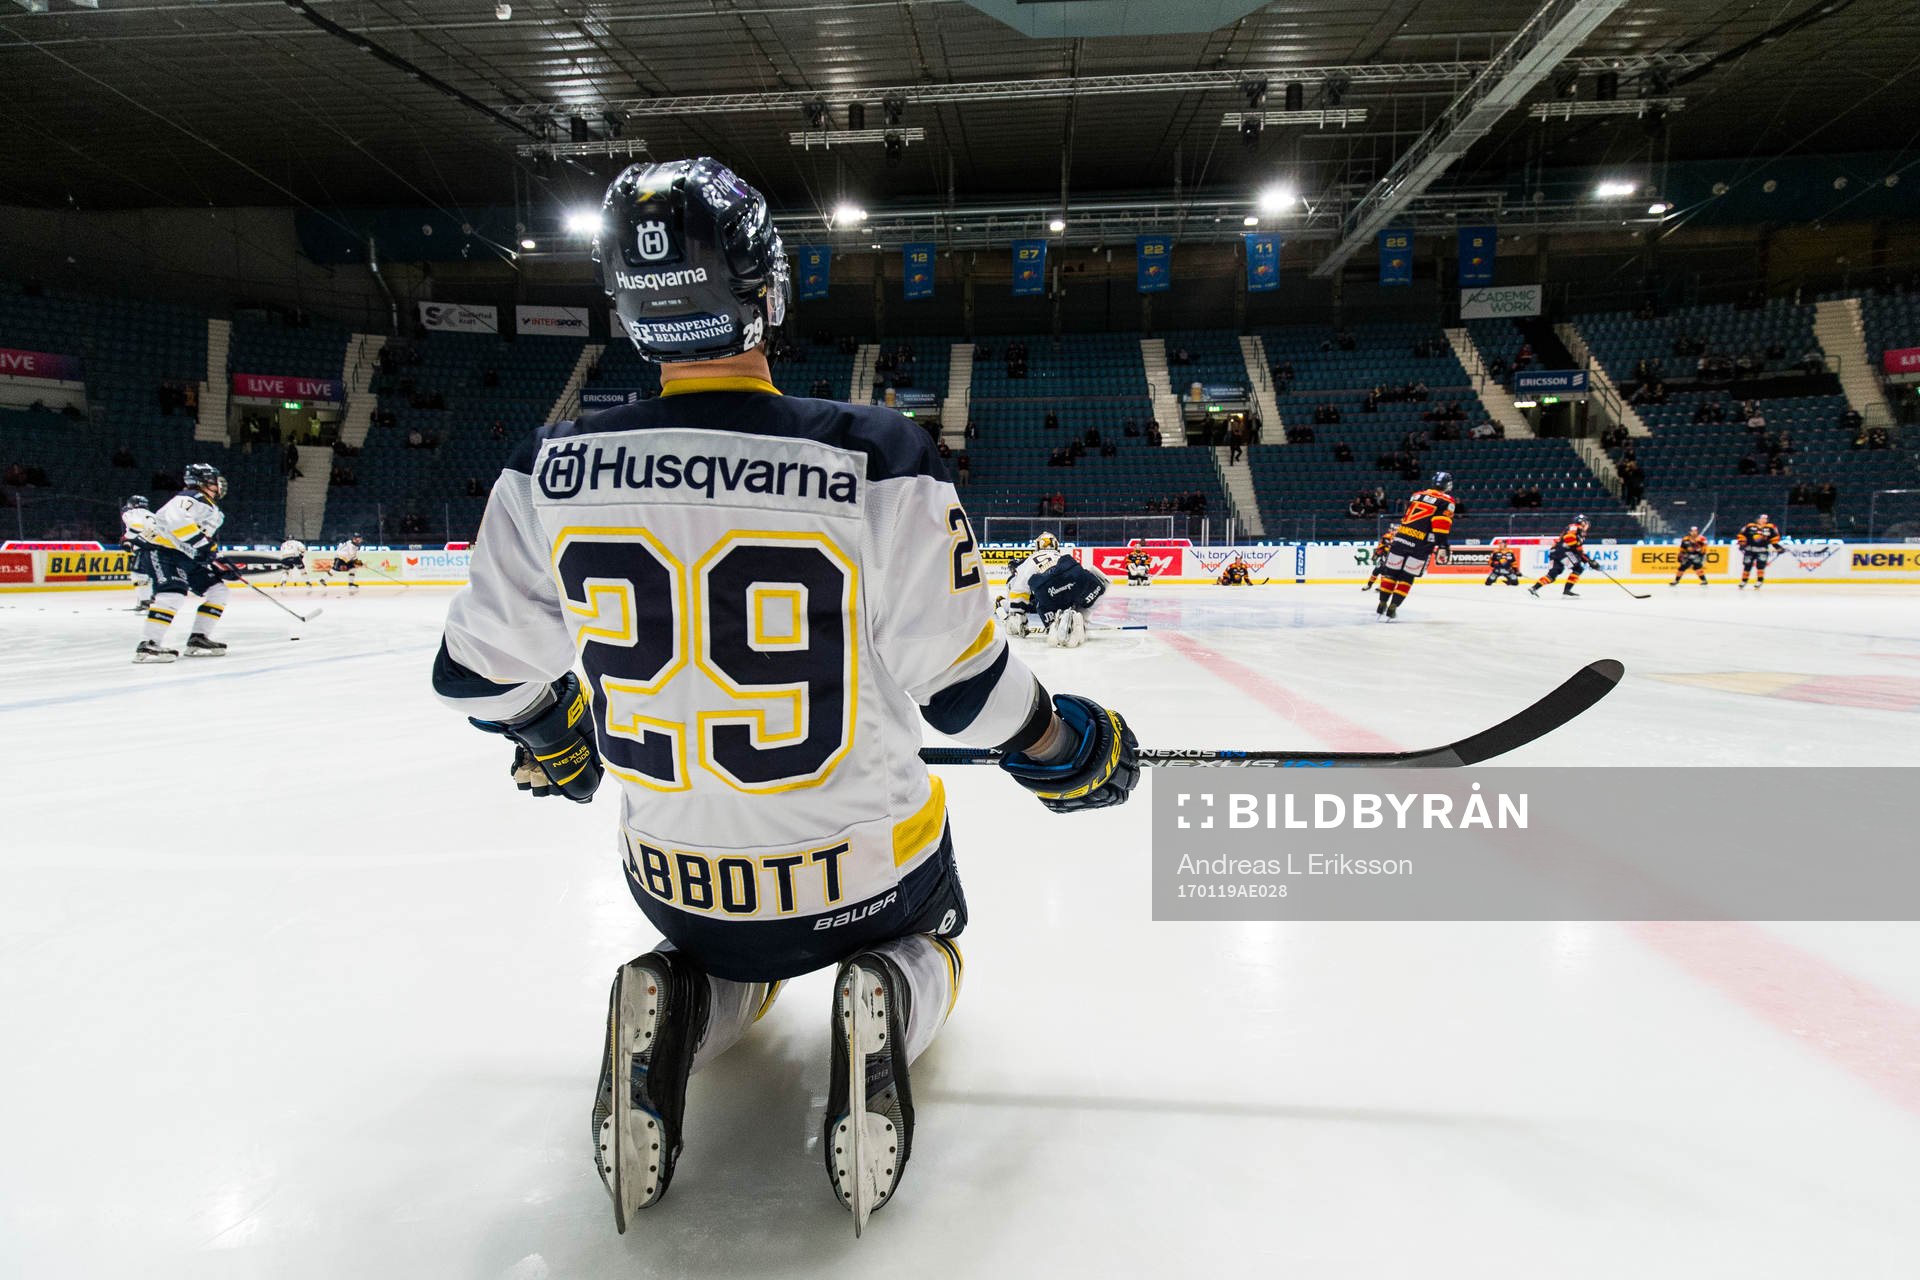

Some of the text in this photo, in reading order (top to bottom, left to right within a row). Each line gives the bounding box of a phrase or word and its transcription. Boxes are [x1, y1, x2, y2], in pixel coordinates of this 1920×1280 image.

[1019, 249, 1040, 259] 27
[1143, 245, 1165, 255] 22
[1255, 243, 1273, 254] 11
[910, 253, 928, 263] 12
[616, 267, 707, 291] Husqvarna
[1467, 289, 1536, 303] ACADEMIC
[531, 317, 582, 328] INTERSPORT
[650, 314, 730, 333] TRANPENAD
[655, 324, 733, 343] BEMANNING
[743, 316, 764, 351] 29
[0, 352, 34, 371] IVE
[249, 378, 332, 396] LIVE LIVE
[1519, 377, 1568, 387] ERICSSON
[583, 393, 624, 403] ERICSSON
[590, 446, 857, 504] Husqvarna
[420, 553, 470, 567] mekst
[1101, 555, 1174, 572] CM
[0, 563, 29, 573] n.se
[552, 526, 859, 795] 29
[552, 745, 588, 768] NEXUS
[573, 750, 590, 765] 1000
[1137, 749, 1217, 758] NEXUS
